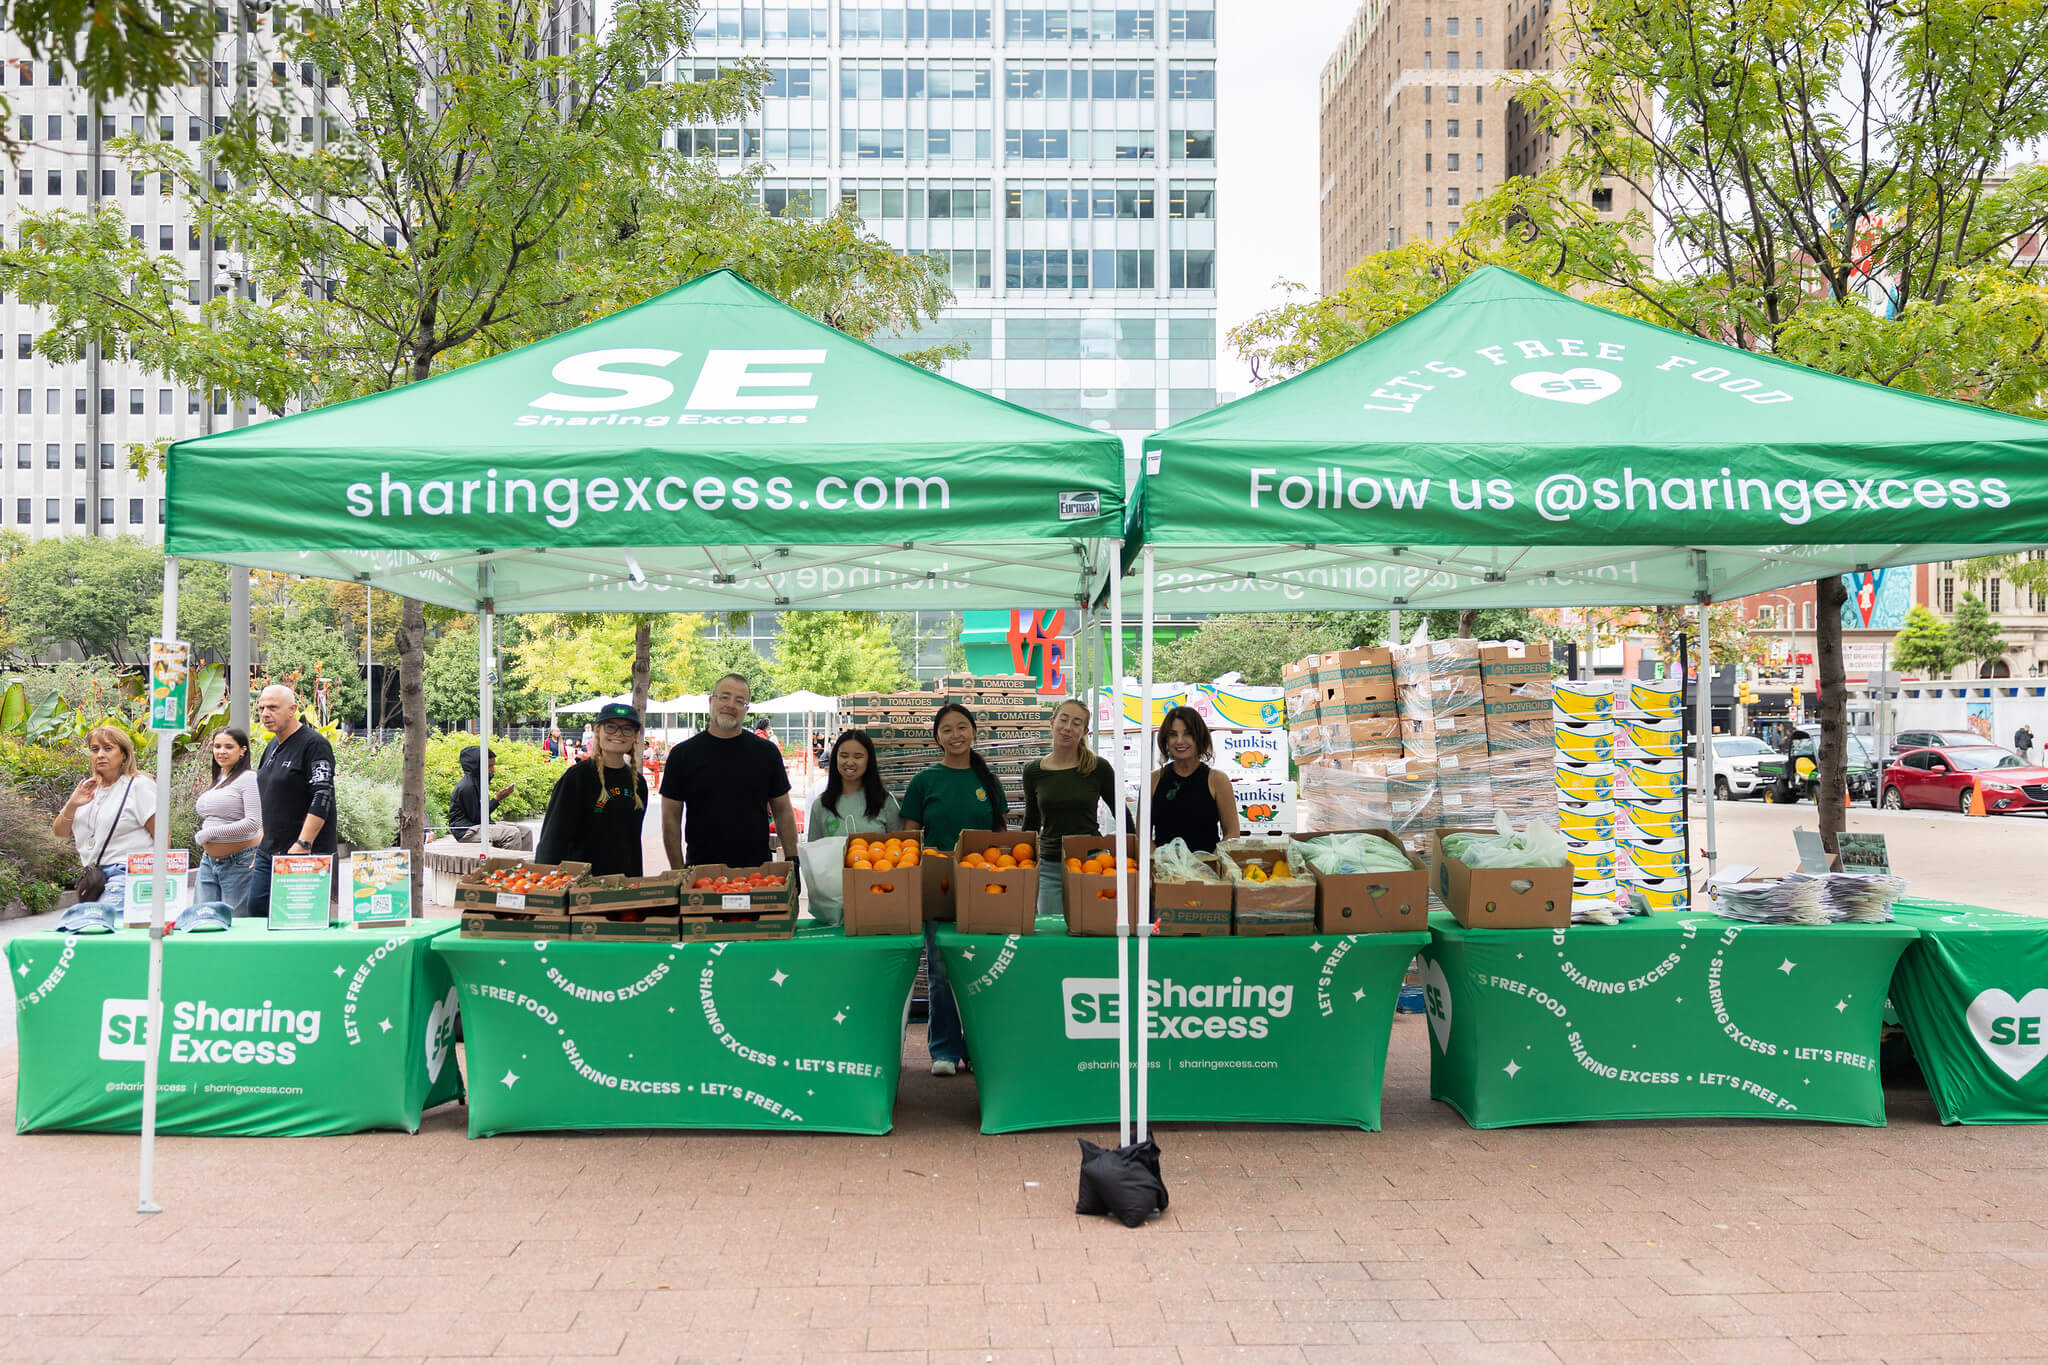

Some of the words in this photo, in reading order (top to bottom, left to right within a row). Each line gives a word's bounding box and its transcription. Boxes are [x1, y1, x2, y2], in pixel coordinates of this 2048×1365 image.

[527, 348, 828, 412] SE
[1363, 360, 1467, 413] LET'S
[1477, 338, 1626, 365] FREE
[1656, 355, 1794, 405] FOOD
[1540, 376, 1602, 393] SE
[513, 412, 670, 427] Sharing
[677, 414, 809, 425] Excess
[346, 468, 951, 528] sharingexcess.com
[1061, 502, 1096, 513] Eurmax
[1249, 467, 1430, 510] Follow
[1450, 477, 1515, 511] us
[1535, 467, 2011, 526] @sharingexcess
[1506, 664, 1548, 673] PEPPERS
[888, 698, 932, 706] TOMATOES
[996, 712, 1041, 720] TOMATES
[1507, 702, 1549, 712] POIVRONS
[888, 715, 932, 723] TOMATOES
[996, 731, 1041, 739] TOMATOES
[1224, 735, 1278, 751] Sunkist
[1234, 788, 1286, 803] Sunkist
[1177, 912, 1229, 922] PEPPERS
[988, 948, 1015, 980] FREE
[1322, 940, 1352, 975] FREE
[1560, 961, 1626, 995] SHARING
[1627, 952, 1681, 992] EXCESS
[37, 966, 66, 998] FREE
[346, 964, 371, 1002] FREE
[546, 967, 616, 1003] SHARING
[617, 962, 670, 1001] EXCESS
[1318, 976, 1334, 1017] LET'S
[1490, 975, 1527, 996] FREE
[1527, 987, 1567, 1018] FOOD
[481, 984, 516, 1004] FREE
[517, 994, 558, 1025] FOOD
[1070, 992, 1120, 1024] SE
[1426, 983, 1446, 1021] SE
[1708, 957, 1730, 1025] SHARING
[1723, 1021, 1777, 1056] EXCESS
[1795, 1047, 1833, 1063] LET'S
[1834, 1050, 1868, 1069] FREE
[173, 1000, 321, 1045] Sharing
[344, 1002, 361, 1045] LET'S
[699, 967, 725, 1035] SHARING
[719, 1032, 777, 1067] EXCESS
[795, 1058, 836, 1074] LET'S
[837, 1061, 873, 1078] FREE
[1989, 1015, 2041, 1046] SE
[169, 1034, 297, 1065] Excess
[1179, 1058, 1278, 1071] sharingexcess.com
[562, 1039, 618, 1088] SHARING
[620, 1078, 681, 1095] EXCESS
[700, 1082, 744, 1099] LET'S
[744, 1091, 783, 1115] FREE
[1568, 1031, 1618, 1079] SHARING
[1619, 1069, 1680, 1085] EXCESS
[1699, 1072, 1741, 1089] LET'S
[1741, 1080, 1779, 1105] FREE
[204, 1083, 303, 1095] sharingexcess.com
